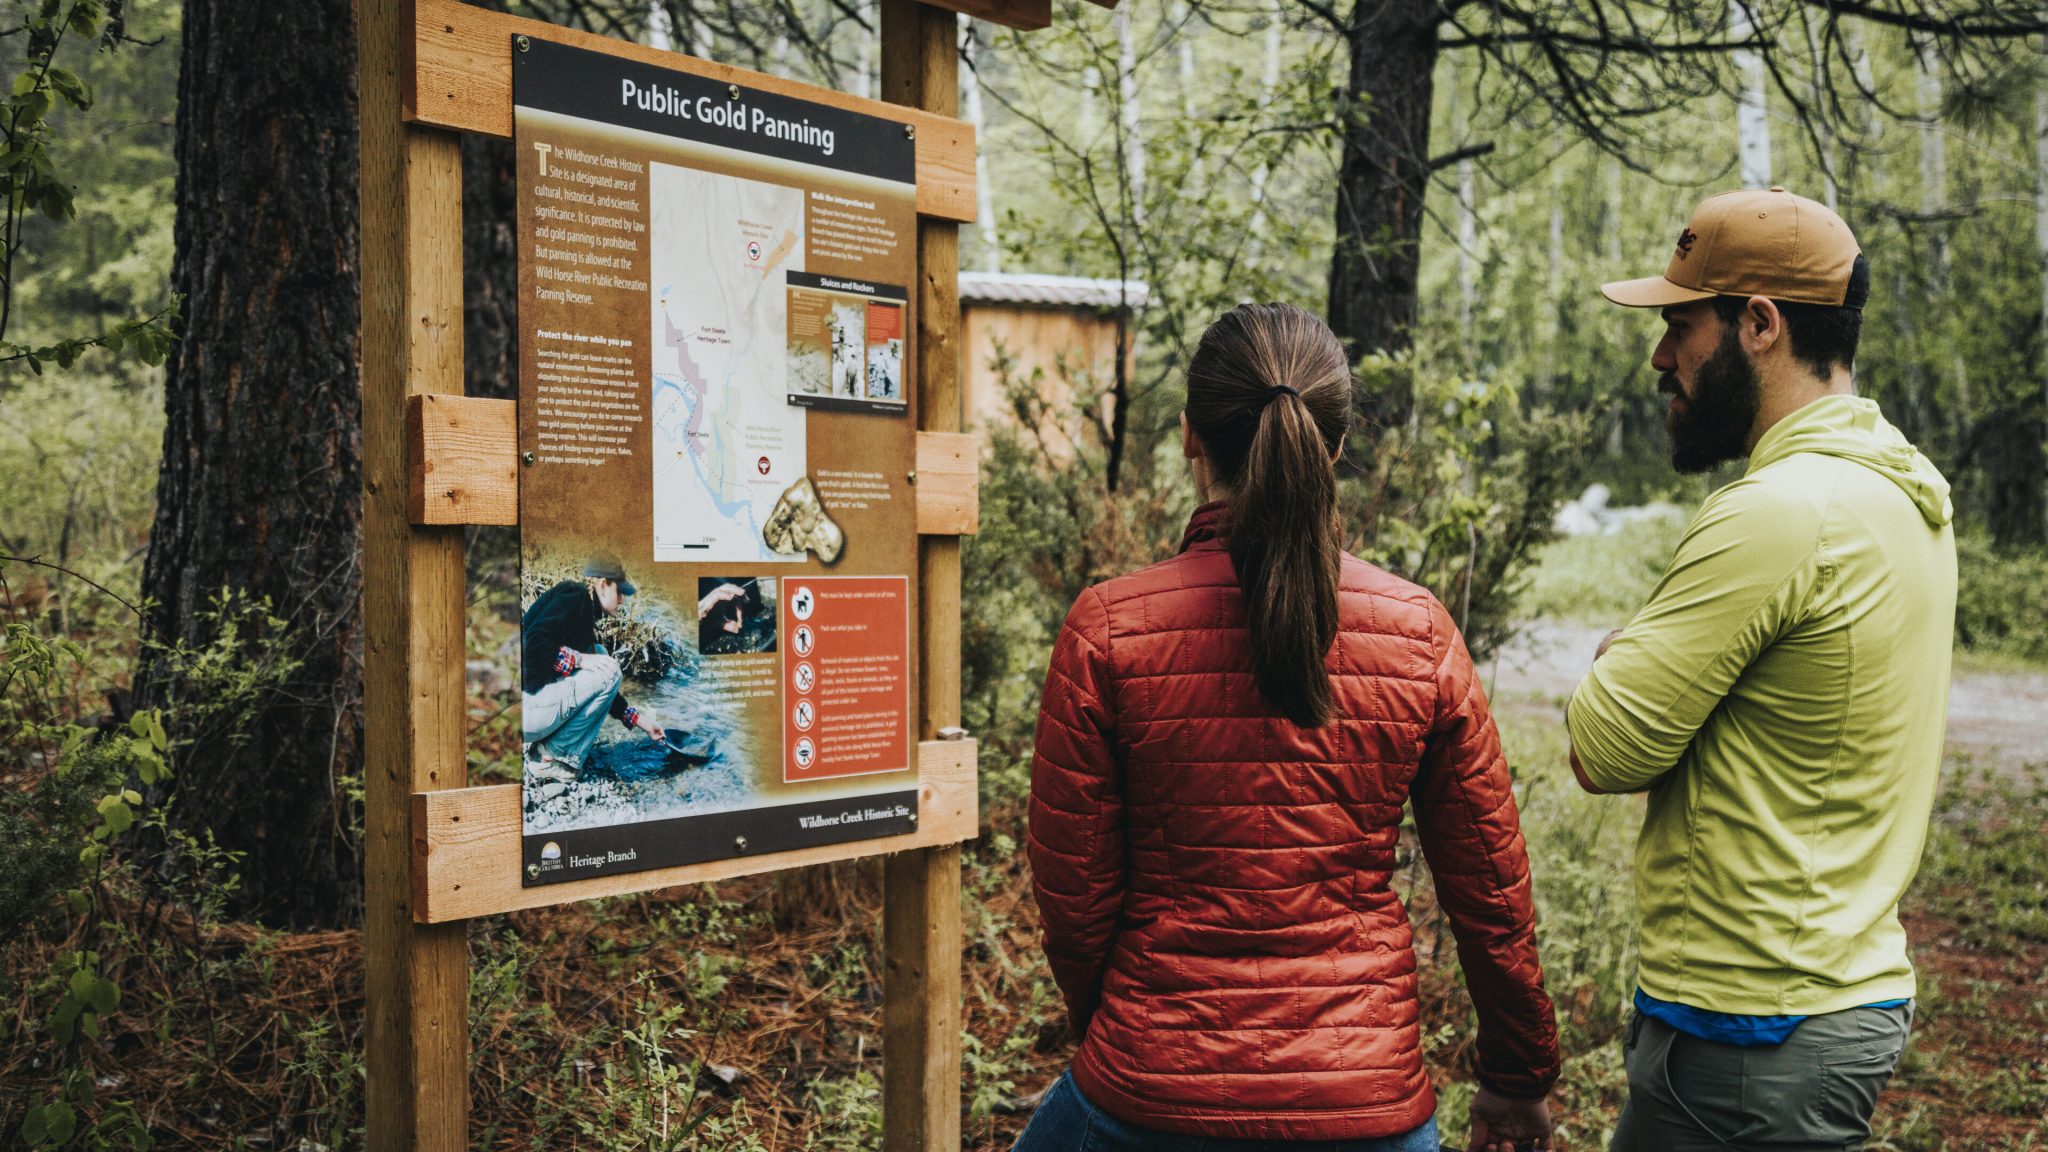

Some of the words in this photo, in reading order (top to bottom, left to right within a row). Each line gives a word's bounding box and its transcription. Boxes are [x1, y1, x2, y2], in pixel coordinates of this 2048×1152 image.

[622, 78, 691, 119] Public
[696, 96, 747, 131] Gold
[752, 107, 834, 156] Panning
[565, 148, 599, 166] Wildhorse
[600, 154, 618, 168] Creek
[620, 158, 644, 174] Historic
[550, 165, 562, 179] Site
[564, 168, 570, 180] is
[571, 171, 575, 181] a
[576, 170, 613, 188] designated
[613, 180, 627, 190] area
[629, 179, 636, 191] of
[534, 183, 563, 200] cultural,
[564, 188, 596, 206] historical,
[598, 195, 610, 208] and
[611, 198, 640, 213] scientific
[535, 205, 576, 222] significance.
[578, 211, 583, 223] It
[584, 212, 590, 224] is
[591, 214, 622, 230] protected
[623, 218, 633, 233] by
[633, 220, 645, 232] law
[535, 226, 549, 238] and
[550, 228, 566, 242] gold
[567, 232, 595, 248] panning
[596, 234, 602, 246] is
[602, 236, 637, 251] prohibited.
[535, 245, 548, 258] But
[549, 249, 577, 265] panning
[578, 251, 584, 264] is
[585, 252, 612, 267] allowed
[612, 258, 620, 268] at
[620, 257, 632, 270] the
[535, 266, 553, 279] Wild
[554, 268, 573, 282] Horse
[574, 270, 591, 284] River
[592, 272, 613, 287] Public
[613, 276, 648, 292] Recreation
[820, 277, 841, 289] Sluices
[840, 280, 853, 290] and
[852, 282, 875, 293] Rockers
[536, 286, 565, 304] Panning
[566, 290, 594, 305] Reserve.
[537, 329, 560, 340] Protect
[561, 332, 573, 341] the
[574, 333, 589, 342] river
[589, 335, 607, 344] while
[607, 338, 620, 347] you
[620, 339, 632, 348] pan
[799, 815, 840, 829] Wildhorse
[840, 809, 863, 824] Creek
[864, 807, 894, 820] Historic
[895, 805, 909, 816] Site
[538, 864, 564, 872] COLUMBIA
[569, 854, 606, 868] Heritage
[607, 848, 637, 863] Branch
